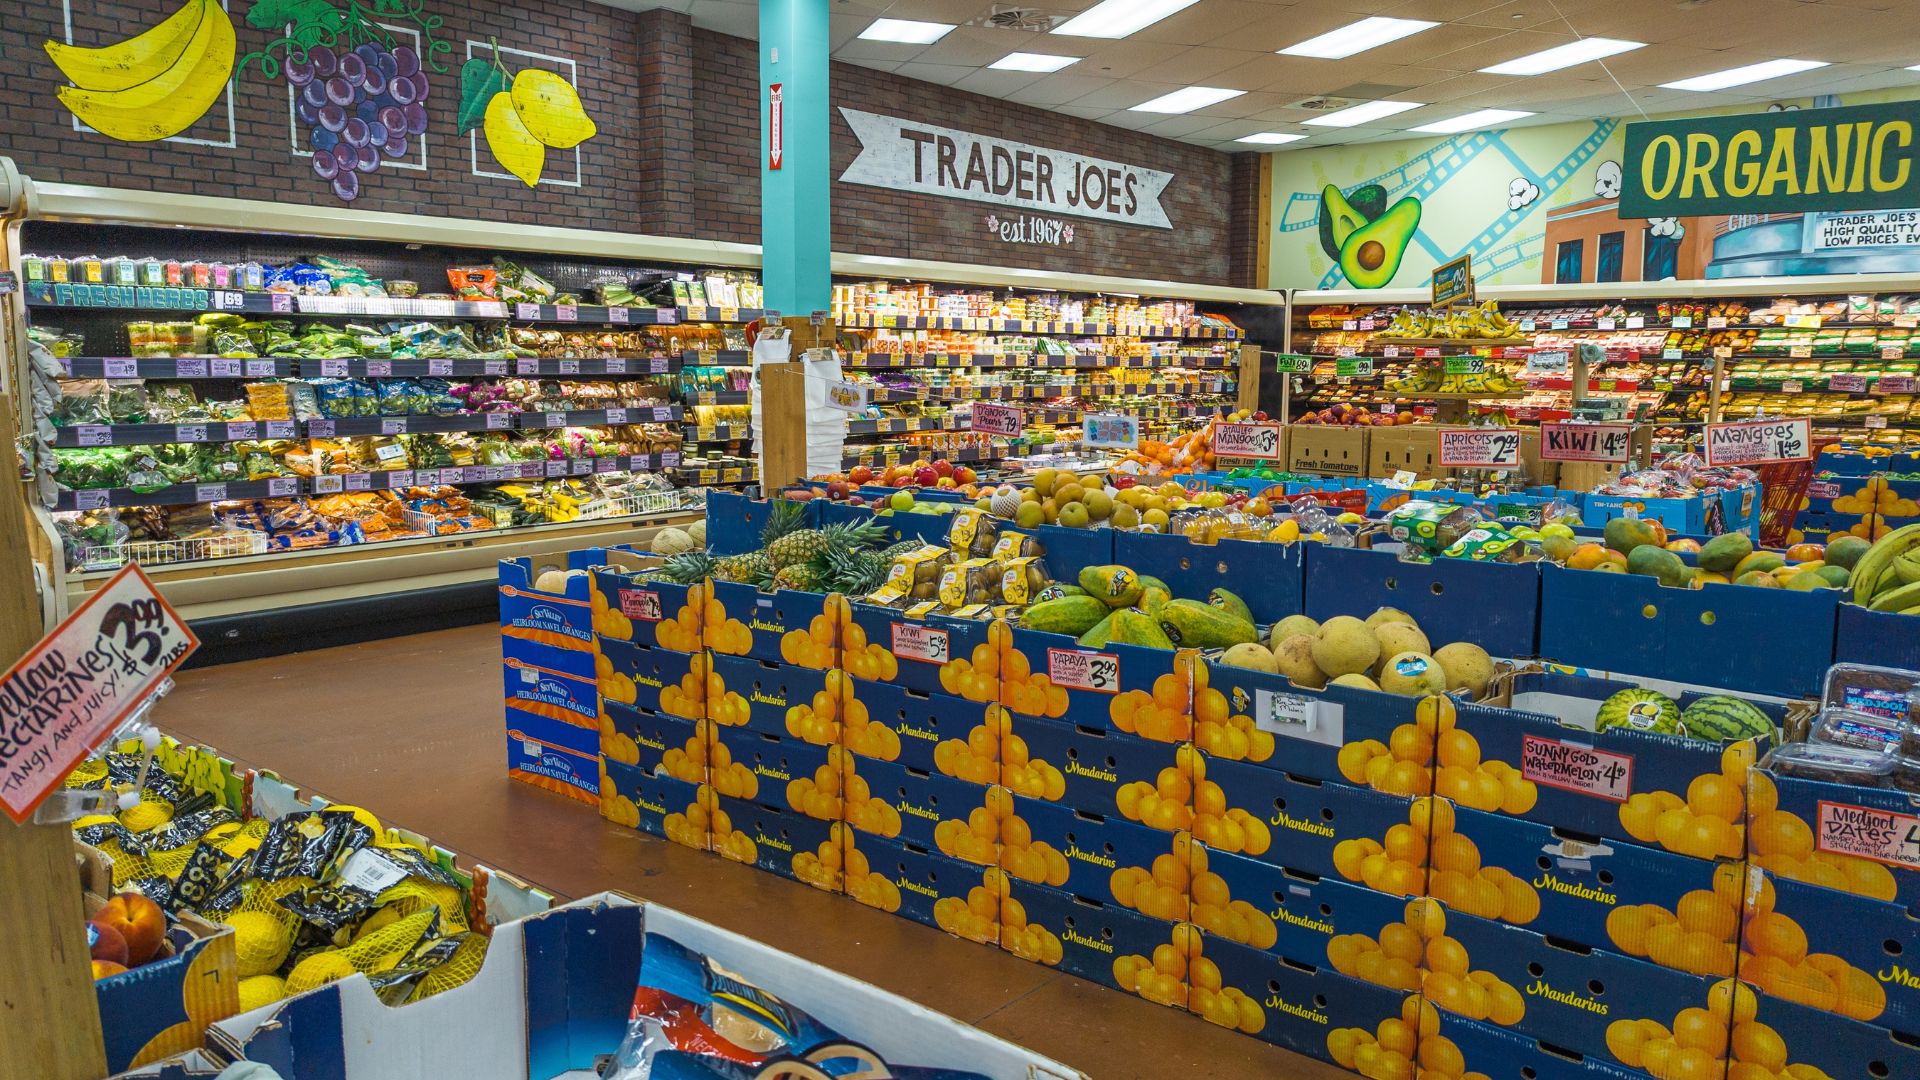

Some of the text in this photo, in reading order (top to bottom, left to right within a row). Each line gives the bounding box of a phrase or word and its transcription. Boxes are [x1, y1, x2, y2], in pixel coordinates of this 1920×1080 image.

[771, 94, 782, 102] FIRE
[1641, 120, 1913, 200] ORGANIC
[901, 128, 1138, 217] TRADER JOE'S
[1823, 223, 1918, 237] HIGH QUALITY
[1828, 212, 1917, 227] TRADER JOE'S
[1825, 236, 1851, 247] LOW
[1857, 234, 1900, 245] PRICES
[55, 283, 134, 307] FRESH
[138, 287, 208, 310] HERBS
[1296, 459, 1359, 471] Fresh Tomatoes
[513, 618, 591, 642] HEIRLOOM NAVEL ORANGES
[749, 618, 785, 633] Mandarins
[1052, 652, 1088, 667] PAPAYA
[633, 673, 662, 688] Mandarins
[517, 690, 596, 718] HEIRLOOM NAVEL ORANGES
[750, 691, 786, 707] Mandarins
[1846, 696, 1906, 712] MEDJOOL
[1860, 706, 1890, 717] DATES
[635, 735, 665, 750] Mandarins
[896, 723, 939, 742] Mandarins
[1526, 740, 1598, 765] SUNNY GOLD
[520, 762, 599, 794] HEIRLOOM NAVEL ORANGES
[754, 764, 790, 781] Mandarins
[1065, 761, 1117, 782] Mandarins
[636, 798, 666, 814] Mandarins
[897, 801, 940, 822] Mandarins
[1270, 812, 1335, 839] Mandarins
[1833, 807, 1898, 830] Medjool
[756, 834, 792, 852] Mandarins
[1830, 841, 1851, 851] Stuff
[1874, 850, 1890, 859] blue
[1065, 845, 1116, 869] Mandarins
[896, 877, 938, 899] Mandarins
[1533, 874, 1617, 905] Mandarins
[1270, 907, 1335, 935] Mandarins
[1062, 929, 1113, 953] Mandarins
[1526, 980, 1609, 1016] Mandarins
[1265, 995, 1329, 1025] Mandarins
